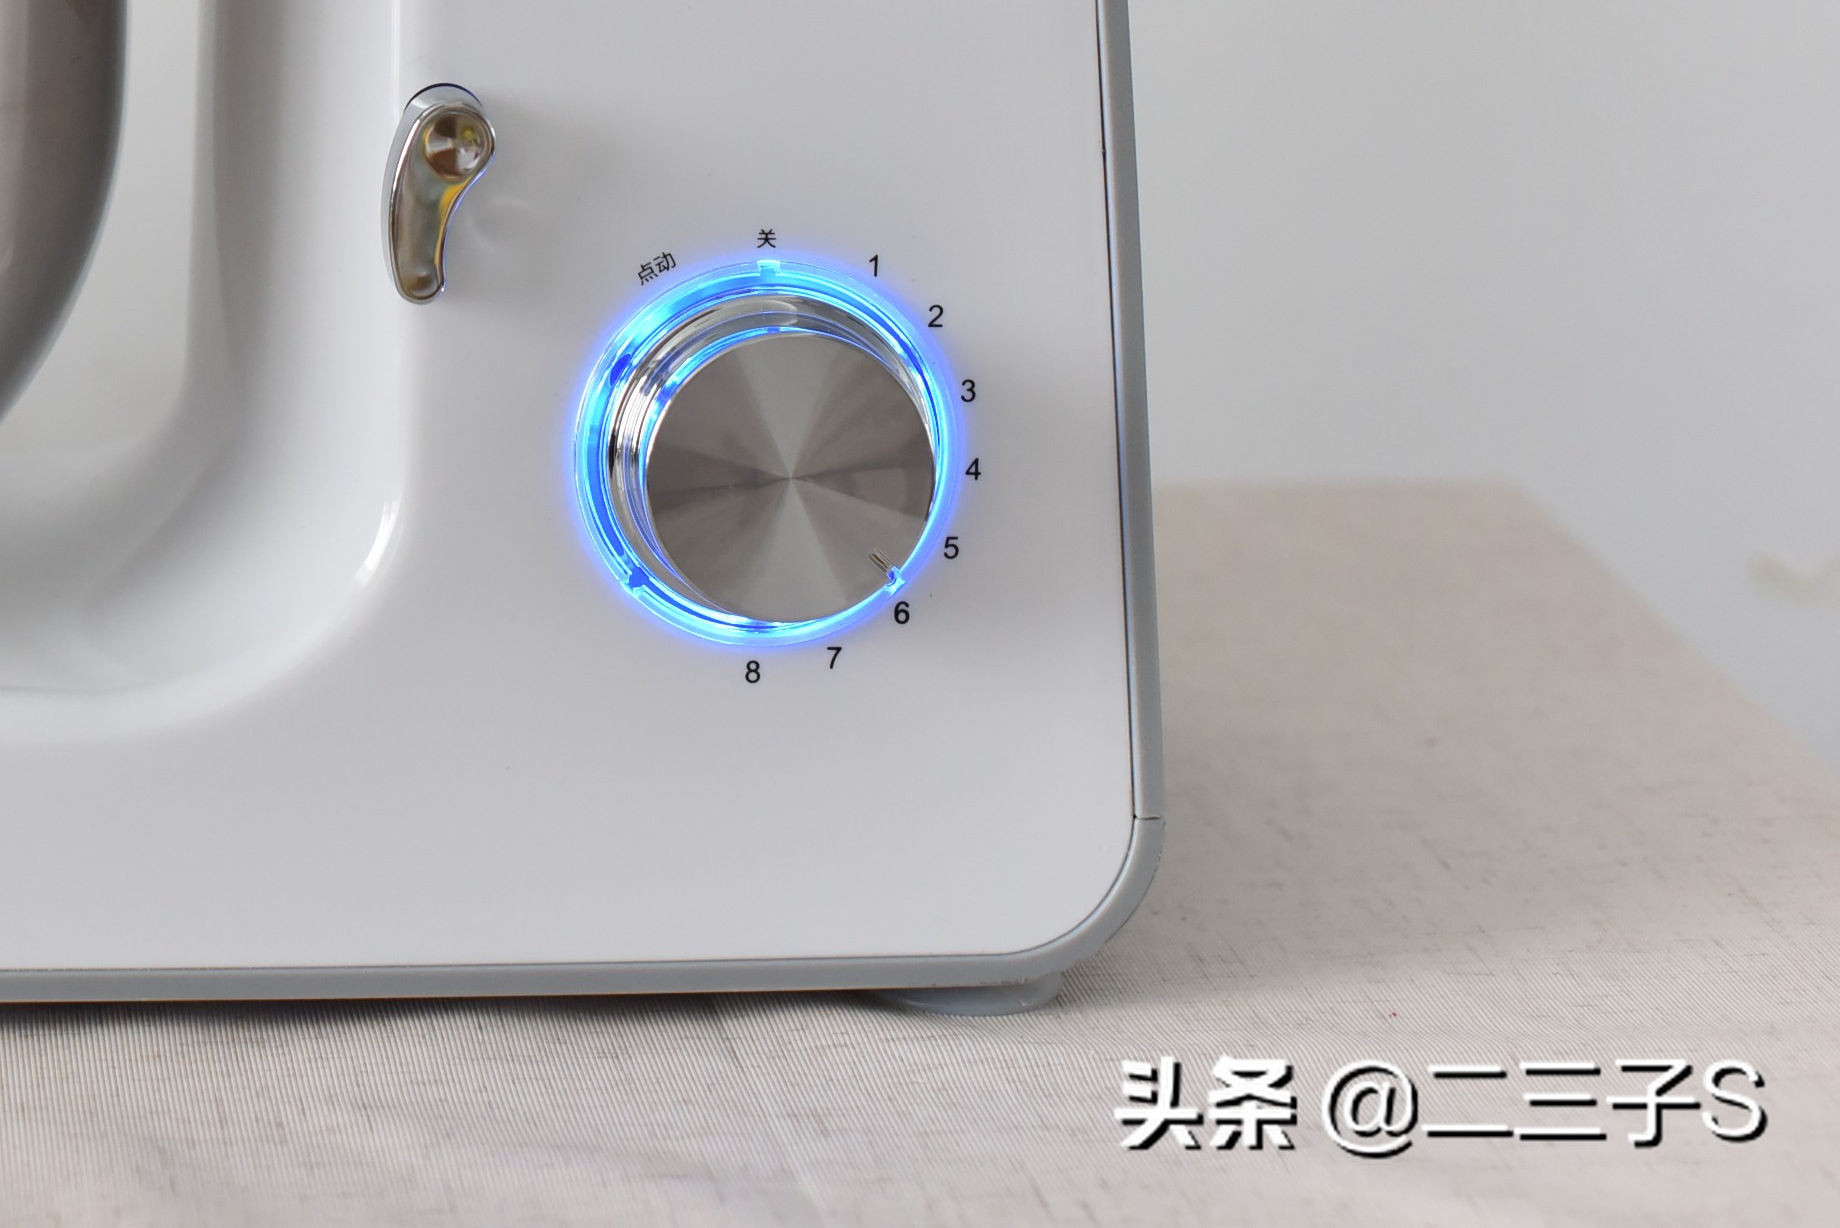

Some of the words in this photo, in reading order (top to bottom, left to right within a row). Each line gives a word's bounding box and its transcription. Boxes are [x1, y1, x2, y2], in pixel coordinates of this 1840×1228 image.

[757, 228, 776, 248] 关
[636, 251, 677, 286] 点动
[869, 254, 879, 277] 1
[927, 304, 944, 328] 2
[960, 378, 977, 403] 3
[965, 457, 982, 481] 4
[943, 536, 960, 560] 5
[893, 600, 910, 625] 6
[826, 646, 843, 670] 7
[744, 660, 761, 684] 8
